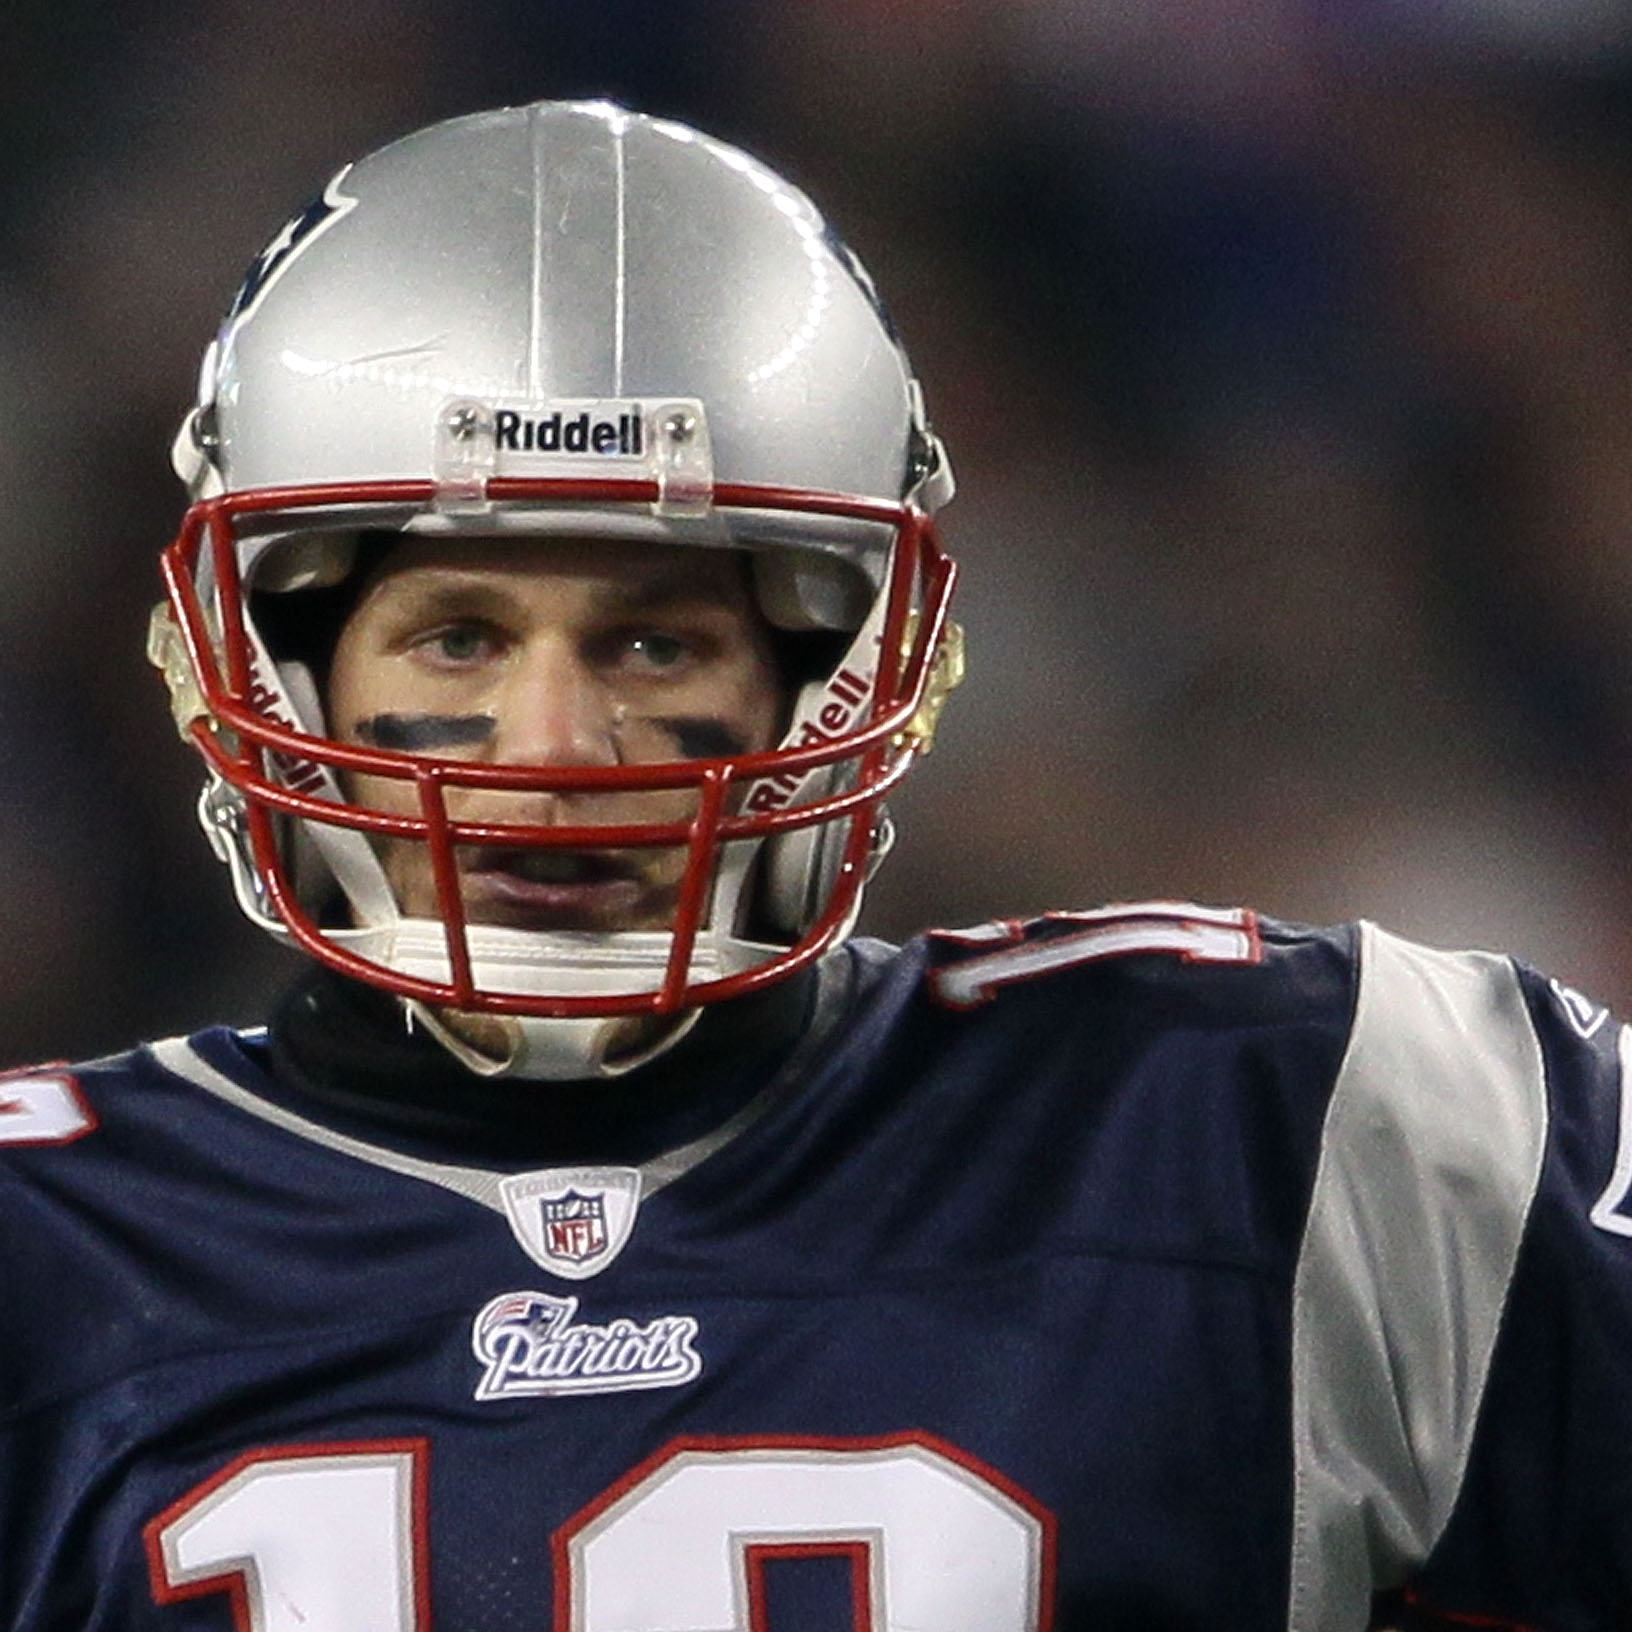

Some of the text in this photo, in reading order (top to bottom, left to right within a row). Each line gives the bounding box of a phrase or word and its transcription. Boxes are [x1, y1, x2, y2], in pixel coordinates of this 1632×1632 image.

[495, 407, 642, 455] Riddell
[746, 669, 870, 811] Ridell
[926, 900, 1263, 1012] 1
[550, 1219, 606, 1254] NFL
[474, 1310, 702, 1399] Patriots
